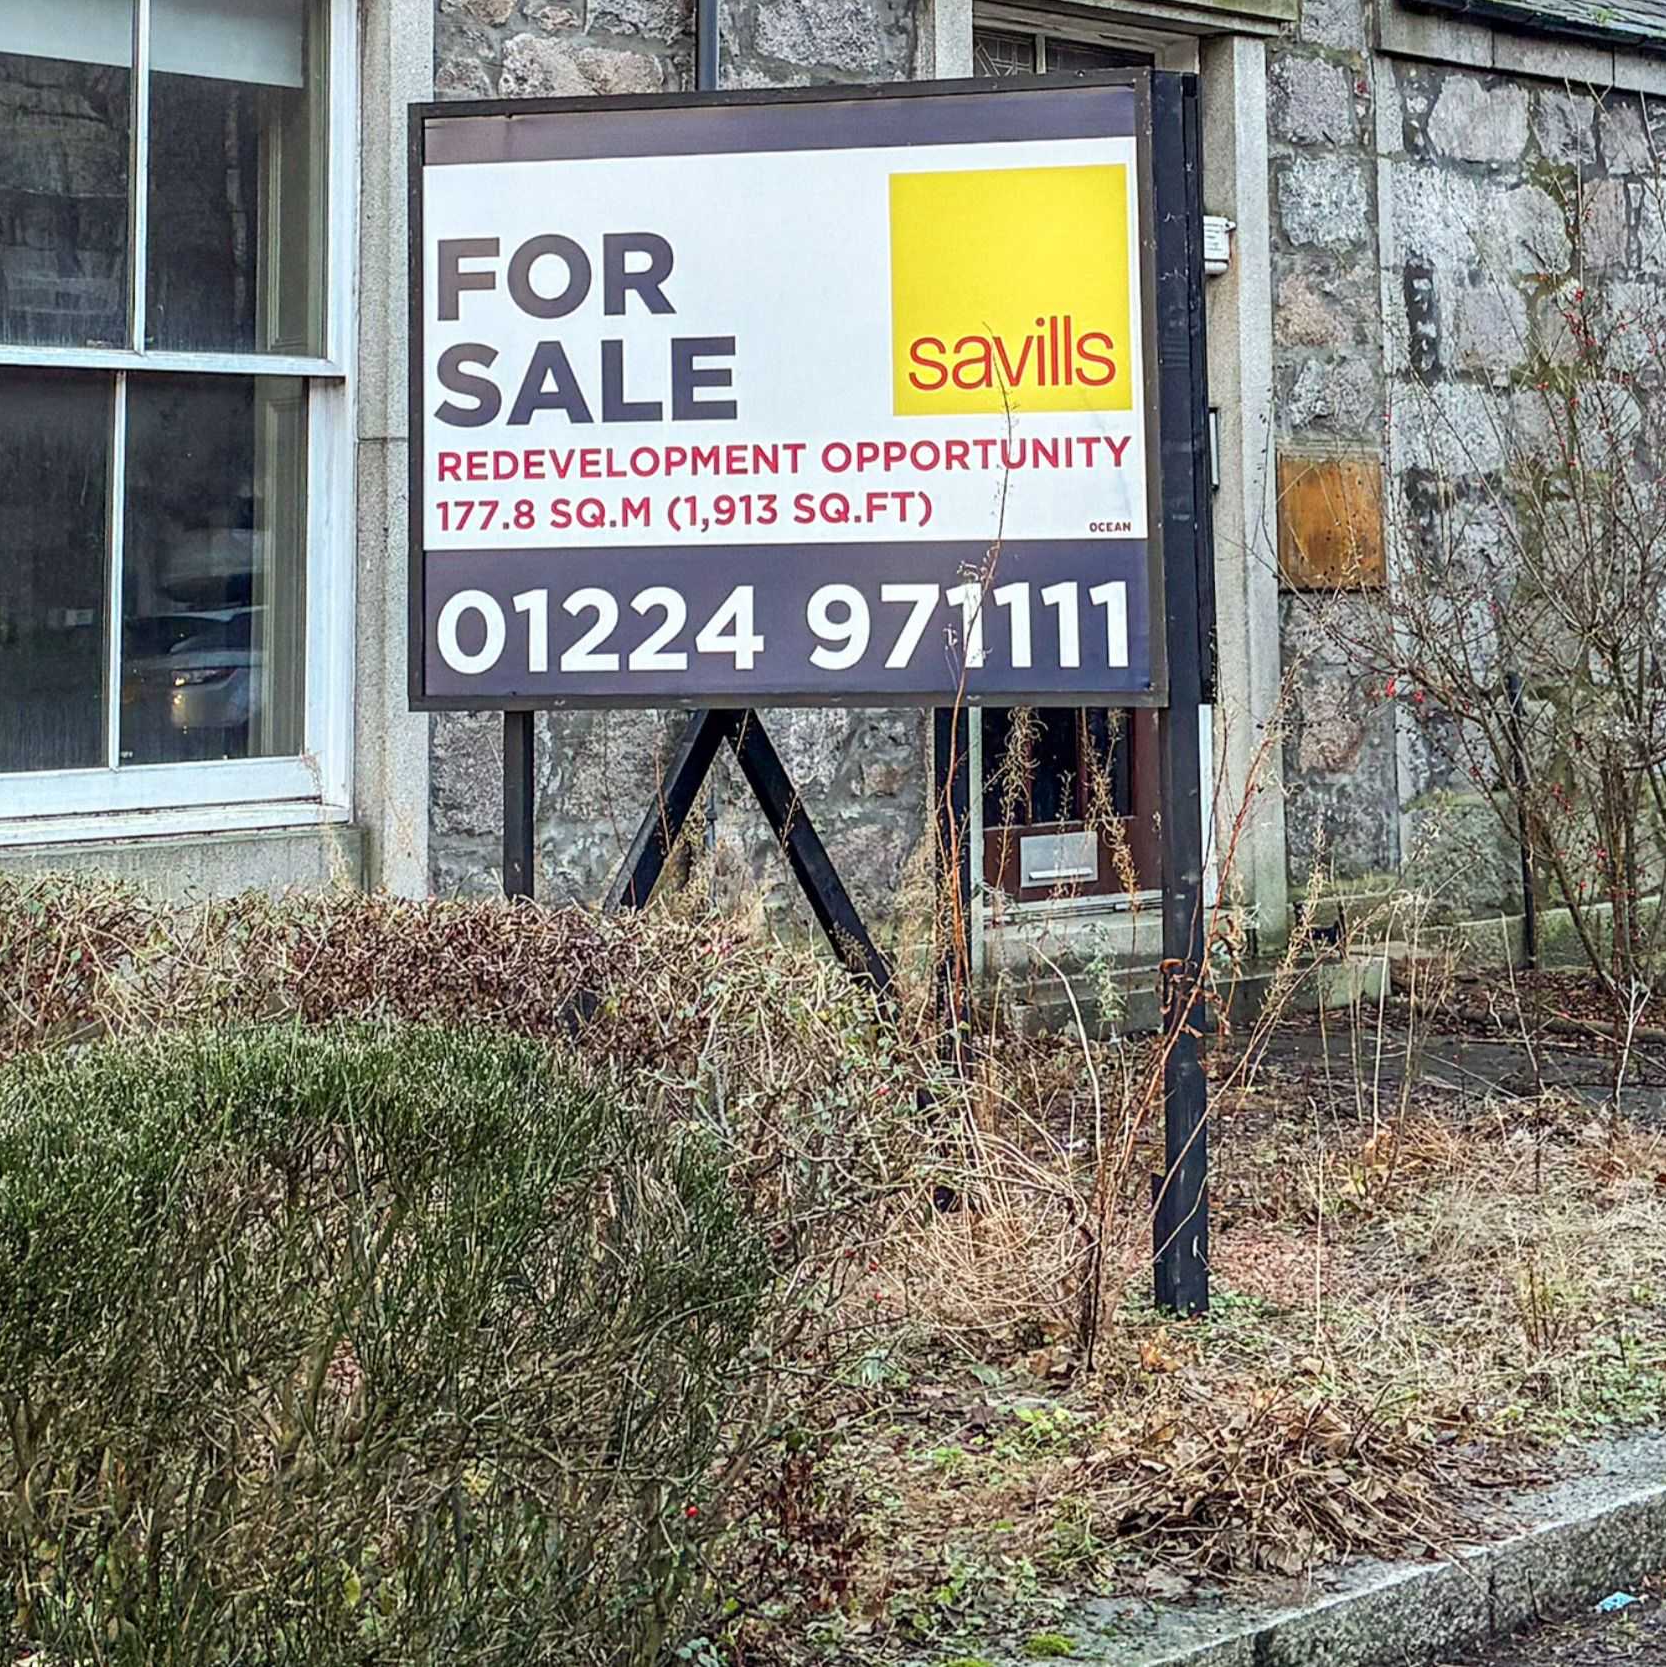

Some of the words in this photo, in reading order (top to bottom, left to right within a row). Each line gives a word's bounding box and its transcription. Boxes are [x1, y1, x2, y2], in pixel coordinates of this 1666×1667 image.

[437, 232, 676, 321] FOR
[434, 336, 737, 427] SALE
[908, 315, 1116, 390] savills
[437, 443, 806, 482] REDEVELOPMENT
[821, 436, 1132, 472] OPPORTUNITY
[436, 500, 535, 531] 177.8
[550, 497, 651, 531] SQ.M
[667, 494, 777, 532] (1,913
[793, 491, 933, 528] SQ.FT)
[1089, 521, 1131, 532] OCEAN
[436, 586, 765, 674] 01224
[806, 580, 1129, 671] 971111
